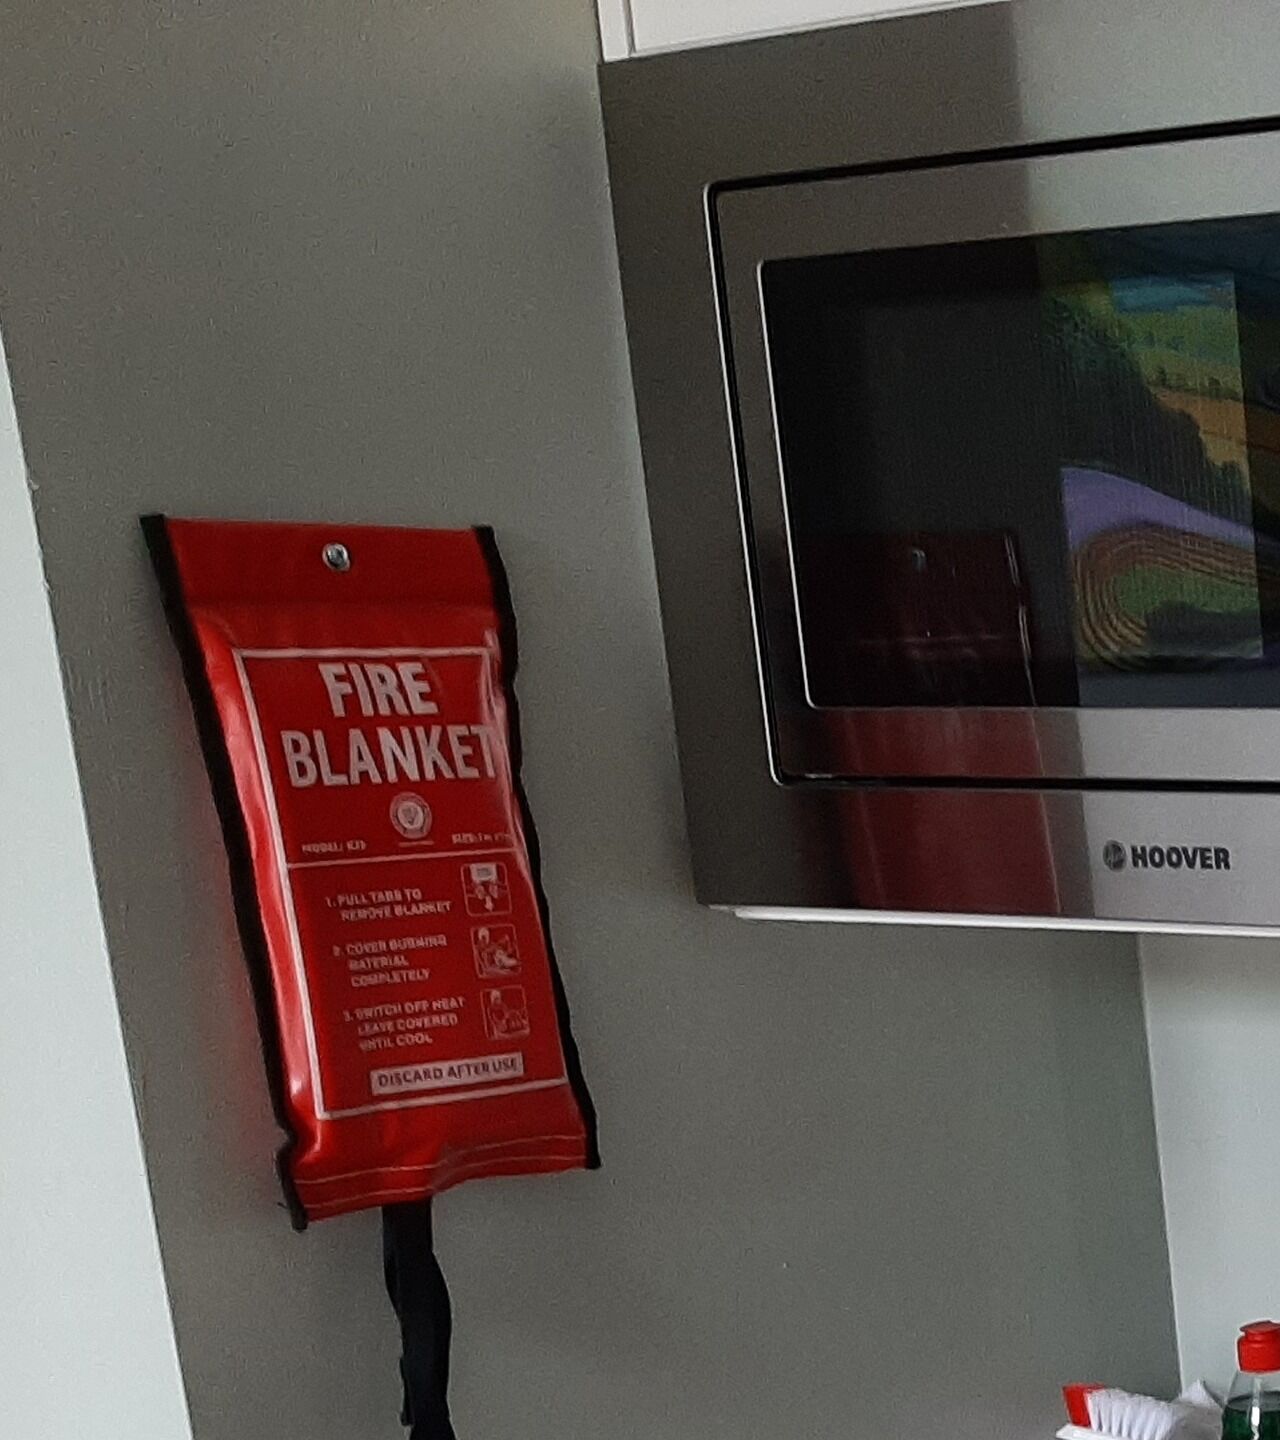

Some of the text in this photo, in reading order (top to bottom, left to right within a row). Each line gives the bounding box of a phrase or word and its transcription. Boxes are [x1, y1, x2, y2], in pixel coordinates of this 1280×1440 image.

[318, 662, 439, 718] FIRE
[281, 724, 497, 788] BLANKET
[1130, 845, 1231, 870] HOOVER
[337, 892, 368, 907] PULL
[404, 888, 422, 902] TO
[340, 901, 452, 922] REMOVE BLANKET
[346, 940, 388, 955] COVER
[348, 956, 409, 971] MATERIAL
[351, 969, 431, 988] COMPLETELY
[354, 1003, 402, 1020] SWITCH
[404, 1000, 430, 1014] OFF
[431, 996, 466, 1010] HEAT
[397, 1013, 458, 1031] COVERED
[396, 1033, 433, 1047] COOL
[377, 1057, 518, 1088] DISCARD AFTER USE
